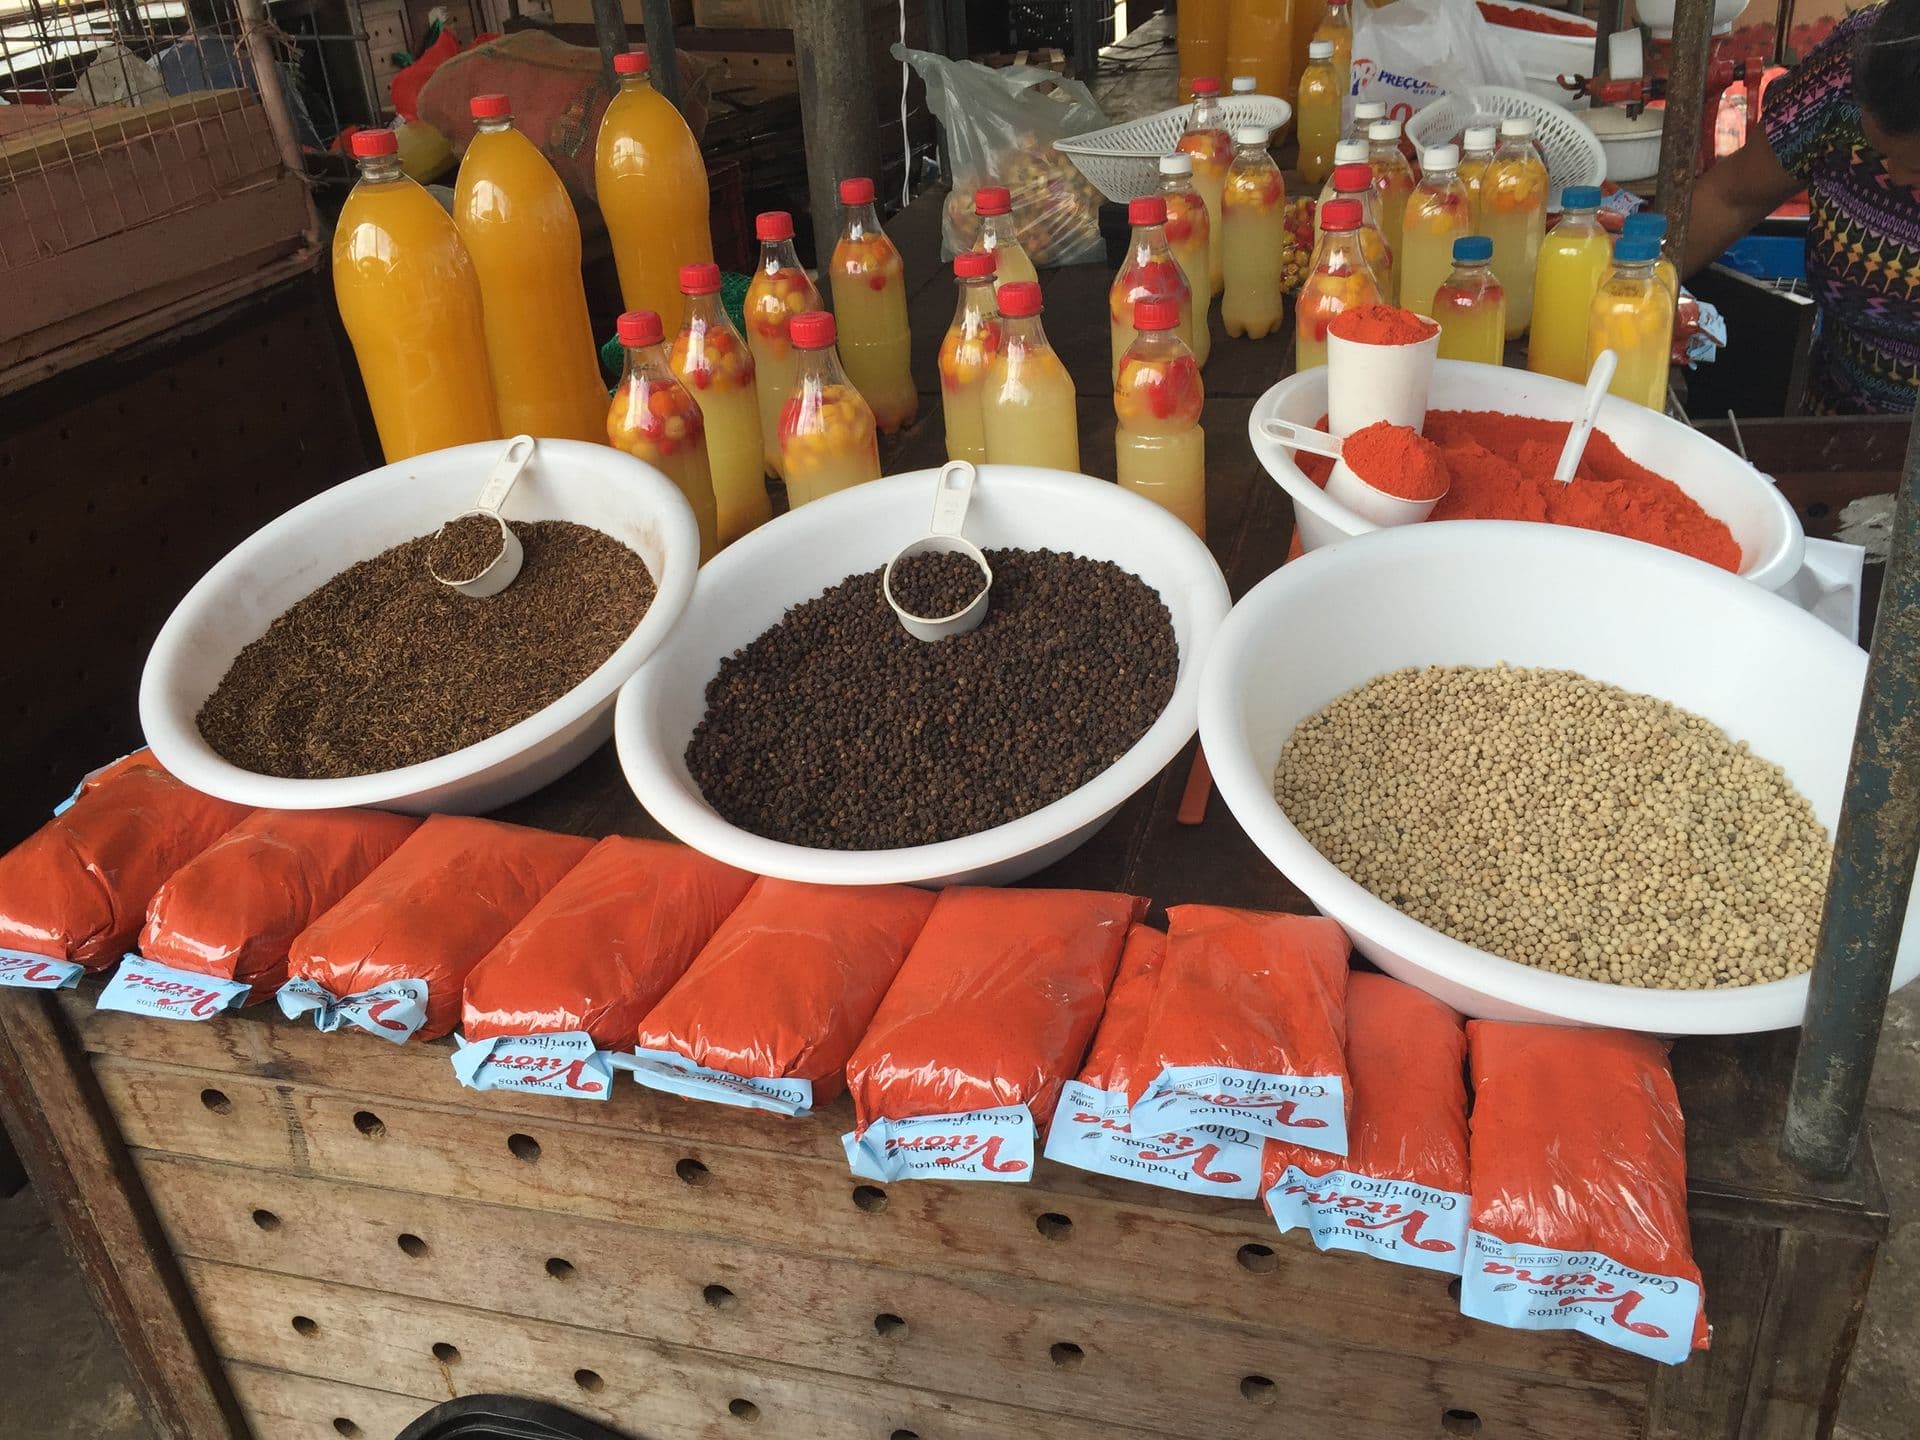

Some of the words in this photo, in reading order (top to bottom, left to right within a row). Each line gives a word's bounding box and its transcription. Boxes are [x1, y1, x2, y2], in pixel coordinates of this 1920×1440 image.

[136, 999, 187, 1017] Produtos
[519, 1037, 588, 1049] lorífico
[498, 1078, 563, 1090] Produtos
[1194, 1076, 1215, 1088] SEM
[1222, 1076, 1324, 1098] Colorífico
[1069, 1095, 1094, 1109] 200g
[1189, 1107, 1274, 1127] Produtos
[1073, 1112, 1242, 1184] Vitria
[1111, 1135, 1171, 1155] Moinho
[907, 1161, 976, 1173] Produtos
[1109, 1154, 1189, 1181] Produtos
[1350, 1179, 1456, 1211] Colorífico
[1318, 1207, 1375, 1224] Moinho
[1318, 1227, 1398, 1251] Produtos
[1475, 1241, 1503, 1256] 200g
[1518, 1256, 1535, 1265] SAL
[1538, 1256, 1559, 1265] SEM
[1567, 1255, 1679, 1295] Colorífico
[1527, 1288, 1587, 1297] Moinho
[1527, 1305, 1606, 1326] Produtos
